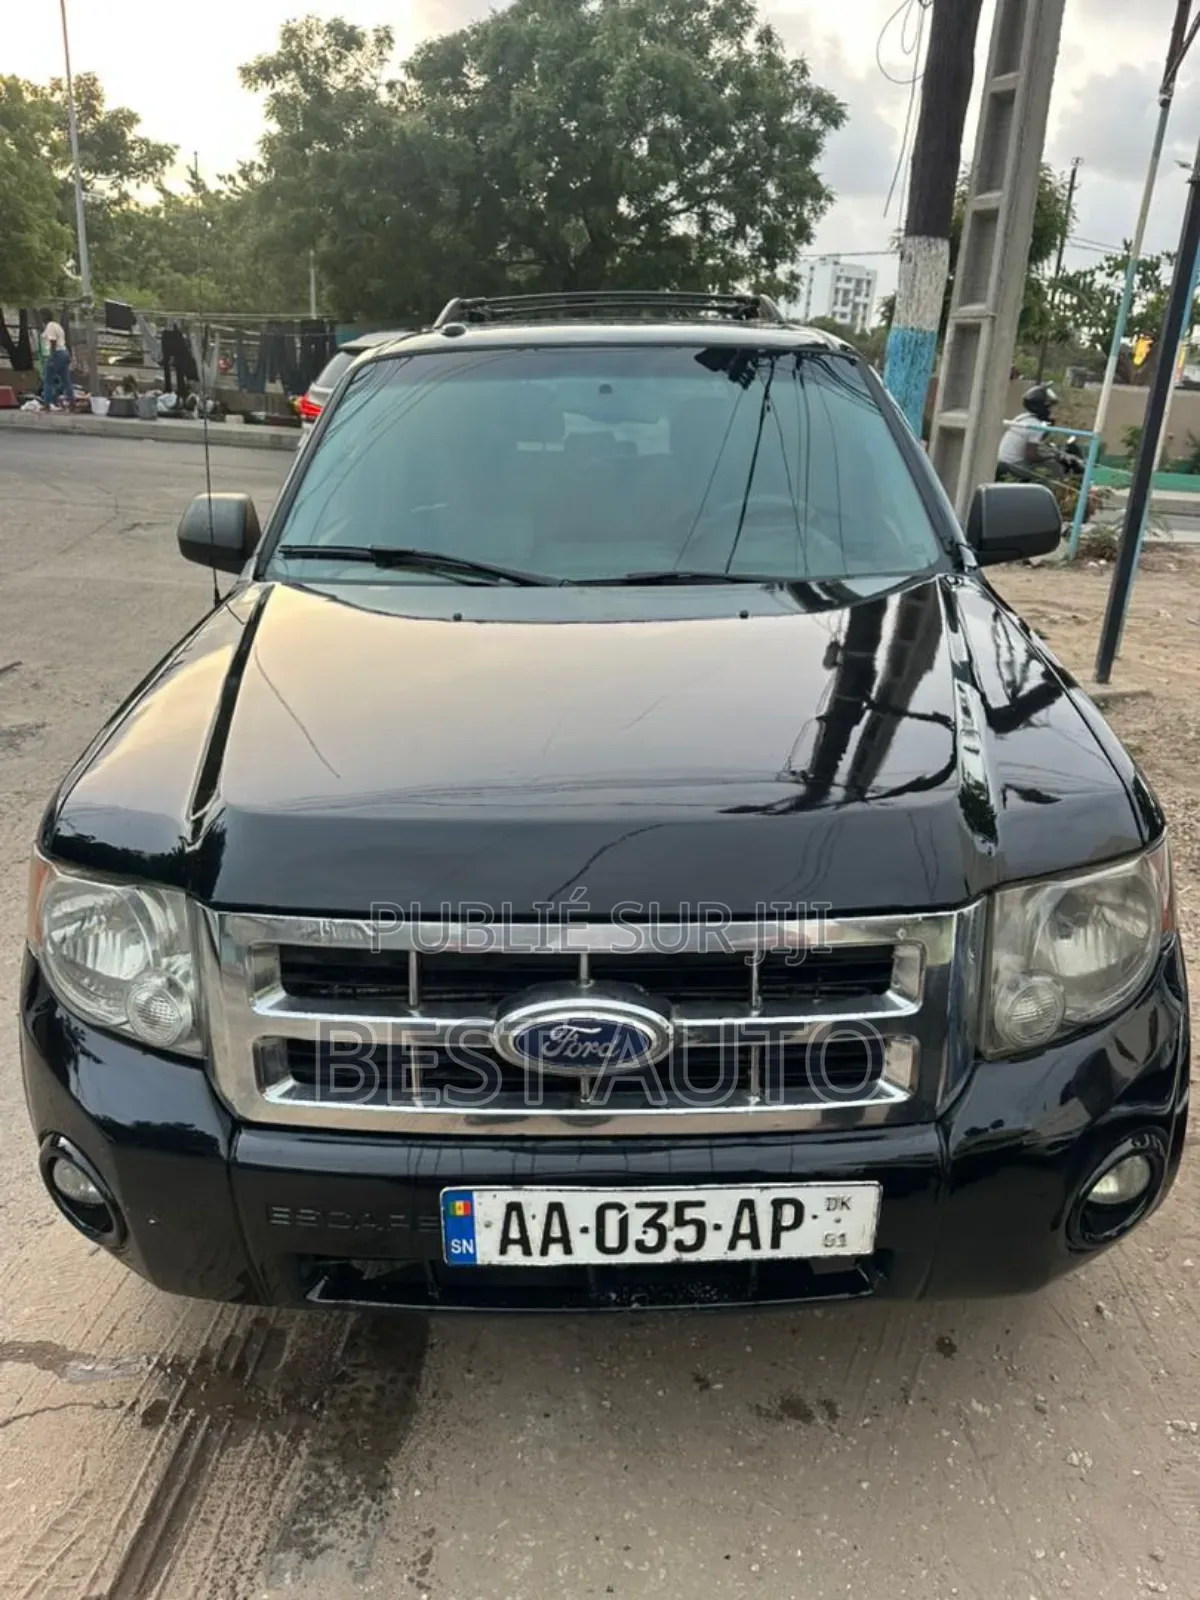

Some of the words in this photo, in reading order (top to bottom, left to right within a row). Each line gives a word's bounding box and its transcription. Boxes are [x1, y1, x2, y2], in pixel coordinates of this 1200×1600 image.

[541, 1024, 621, 1058] Ford
[825, 1196, 852, 1211] DK
[451, 1238, 475, 1255] SN
